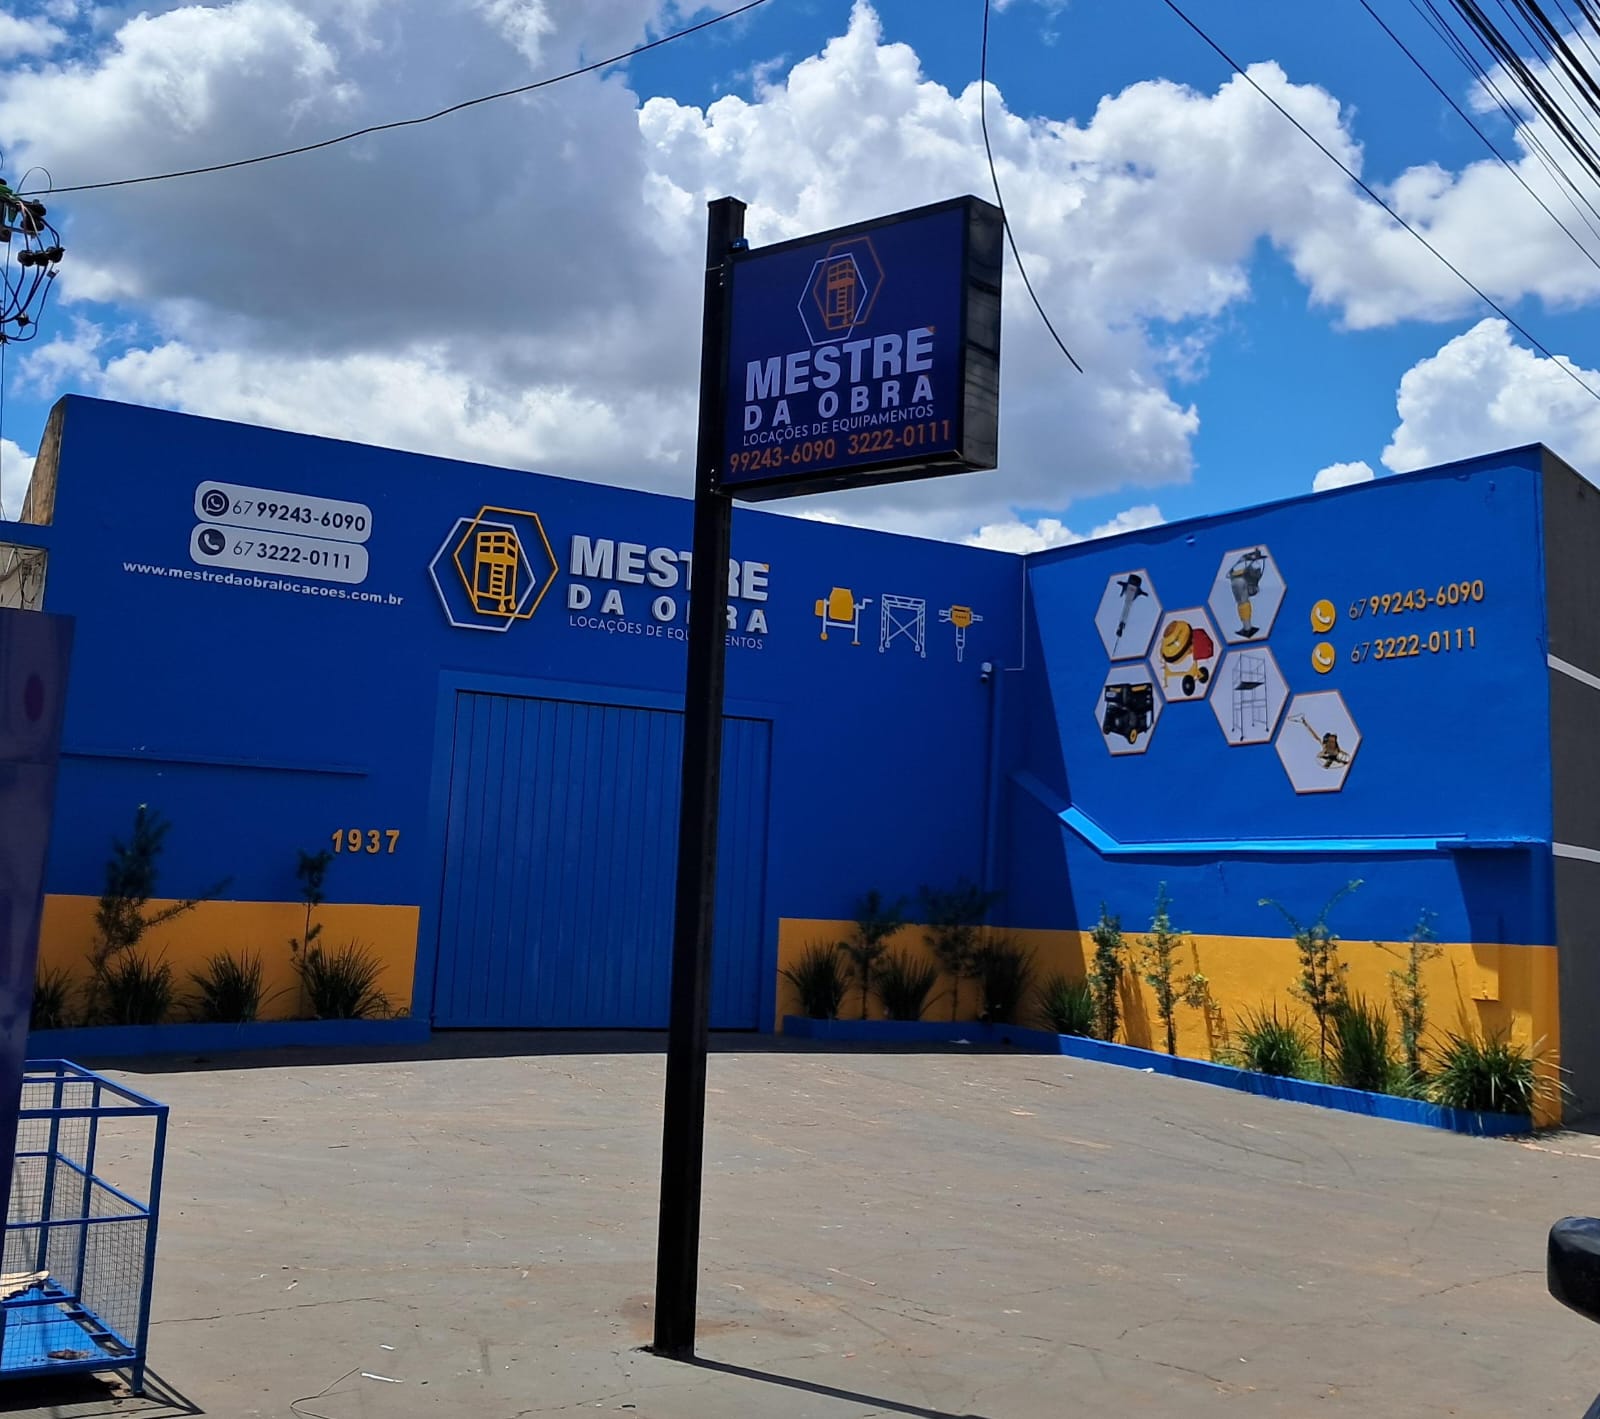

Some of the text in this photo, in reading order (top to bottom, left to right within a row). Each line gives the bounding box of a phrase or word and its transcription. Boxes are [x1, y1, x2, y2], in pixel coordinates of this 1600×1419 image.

[745, 326, 936, 402] MESTRE
[743, 375, 934, 431] DA OBRA
[743, 404, 934, 447] LOCAÇÕES DE EQUIPAMENTOS
[730, 420, 951, 473] 99243-6090 3222-0111
[232, 500, 366, 532] 67 99243-6090
[233, 540, 351, 569] 67 3222-0111
[123, 561, 404, 606] www.mestredaobralocacoes.com.br
[1348, 579, 1484, 619] 67 99243-6090
[567, 583, 769, 634] DA OA
[569, 615, 764, 650] LOCAÇÕES DE EQENTOS
[1351, 626, 1476, 663] 67 3222-0111
[332, 828, 400, 854] 1937
